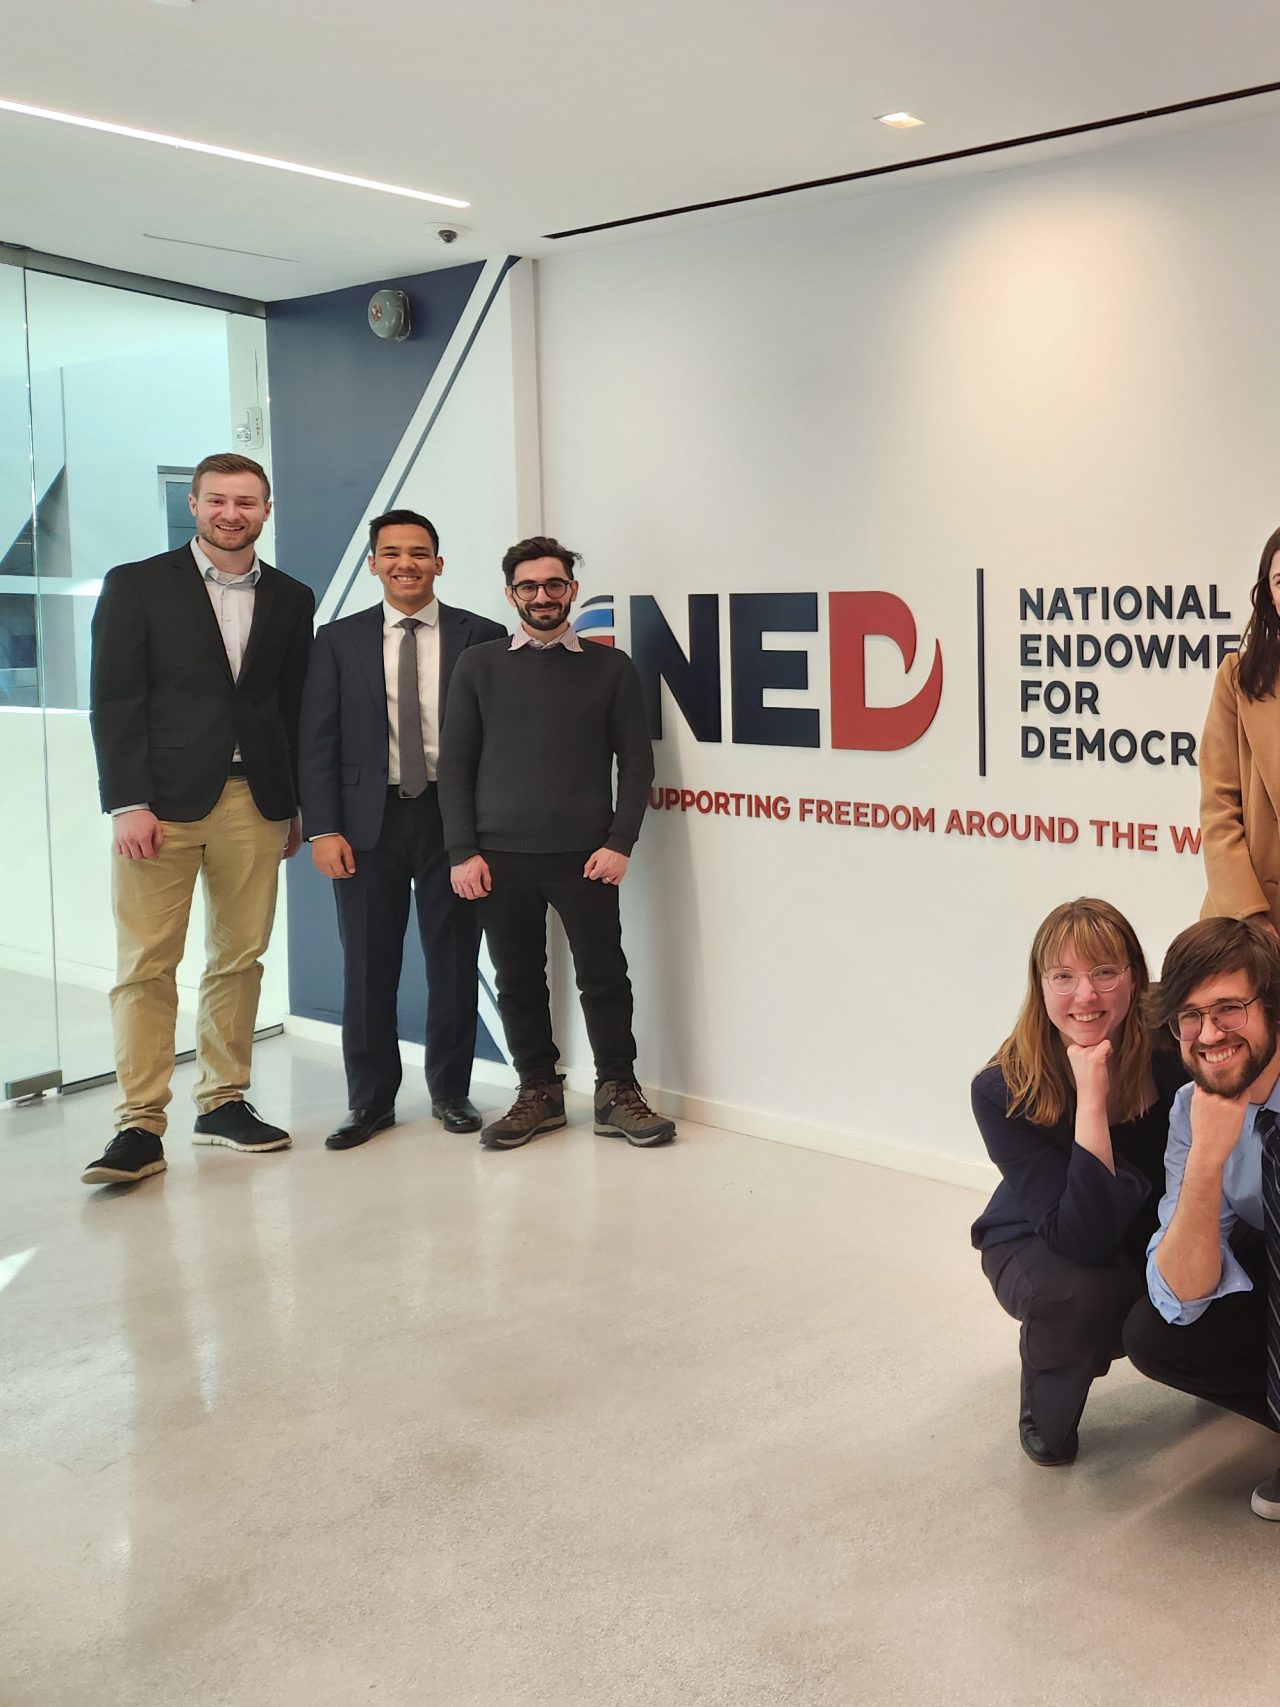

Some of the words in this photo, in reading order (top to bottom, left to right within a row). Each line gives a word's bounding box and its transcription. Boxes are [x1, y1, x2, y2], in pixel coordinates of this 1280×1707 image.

[1019, 584, 1231, 620] NATIONAL
[1020, 633, 1252, 668] ENDOWME
[630, 591, 943, 752] NED
[1020, 680, 1100, 714] FOR
[1021, 726, 1198, 766] DEMOCR
[650, 787, 791, 821] UPPORTING
[799, 798, 935, 832] FREEDOM
[944, 809, 1079, 844] AROUND
[1089, 819, 1158, 851] THE
[1169, 825, 1202, 854] W
